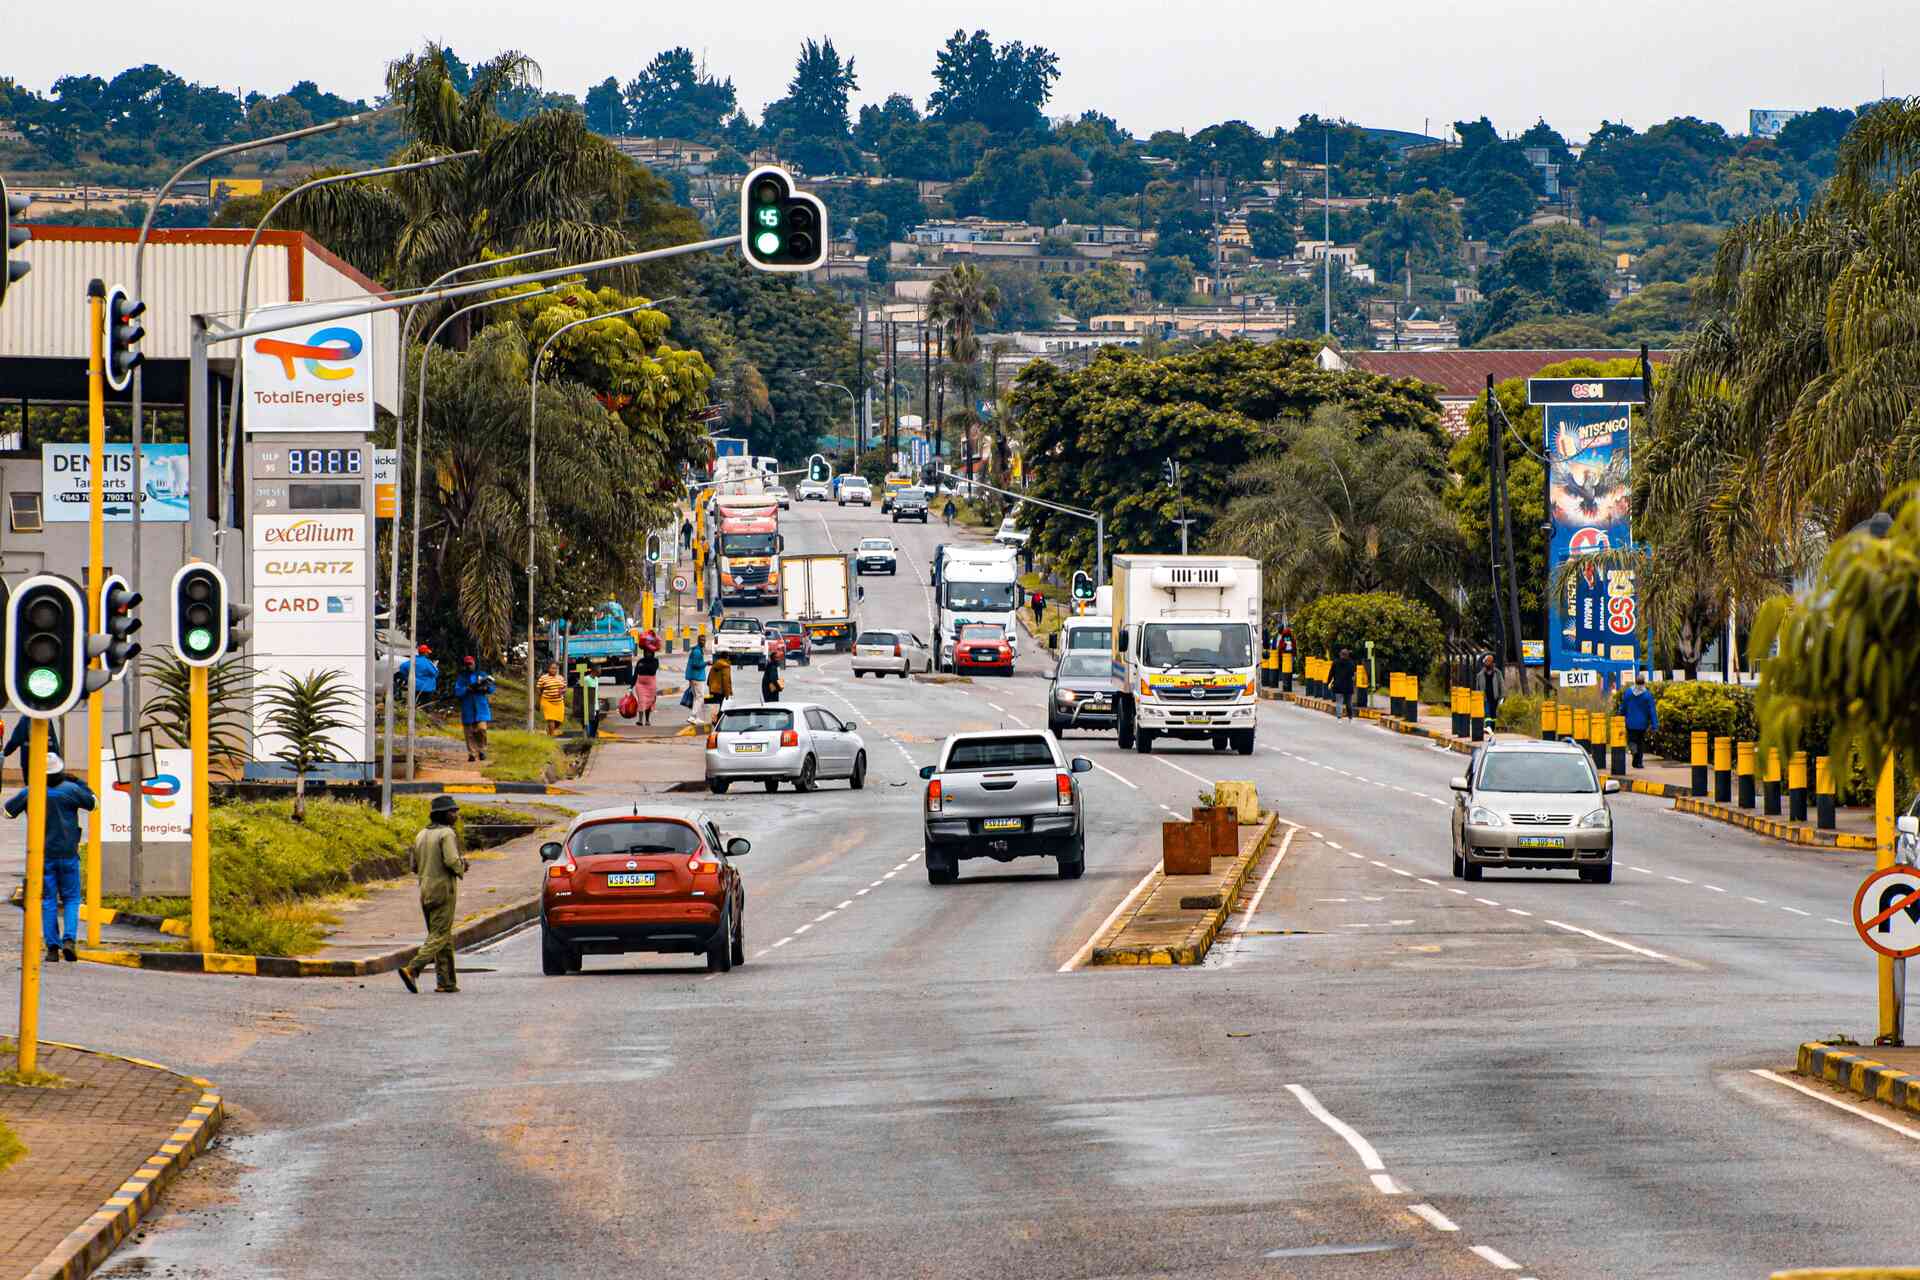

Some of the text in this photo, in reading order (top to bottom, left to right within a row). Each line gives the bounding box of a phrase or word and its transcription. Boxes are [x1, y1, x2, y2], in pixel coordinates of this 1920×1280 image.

[254, 390, 365, 407] TotalEnergies
[265, 522, 354, 543] excellium
[265, 561, 353, 574] QUARTZ
[265, 598, 320, 612] CARD
[1567, 672, 1589, 684] EXIT
